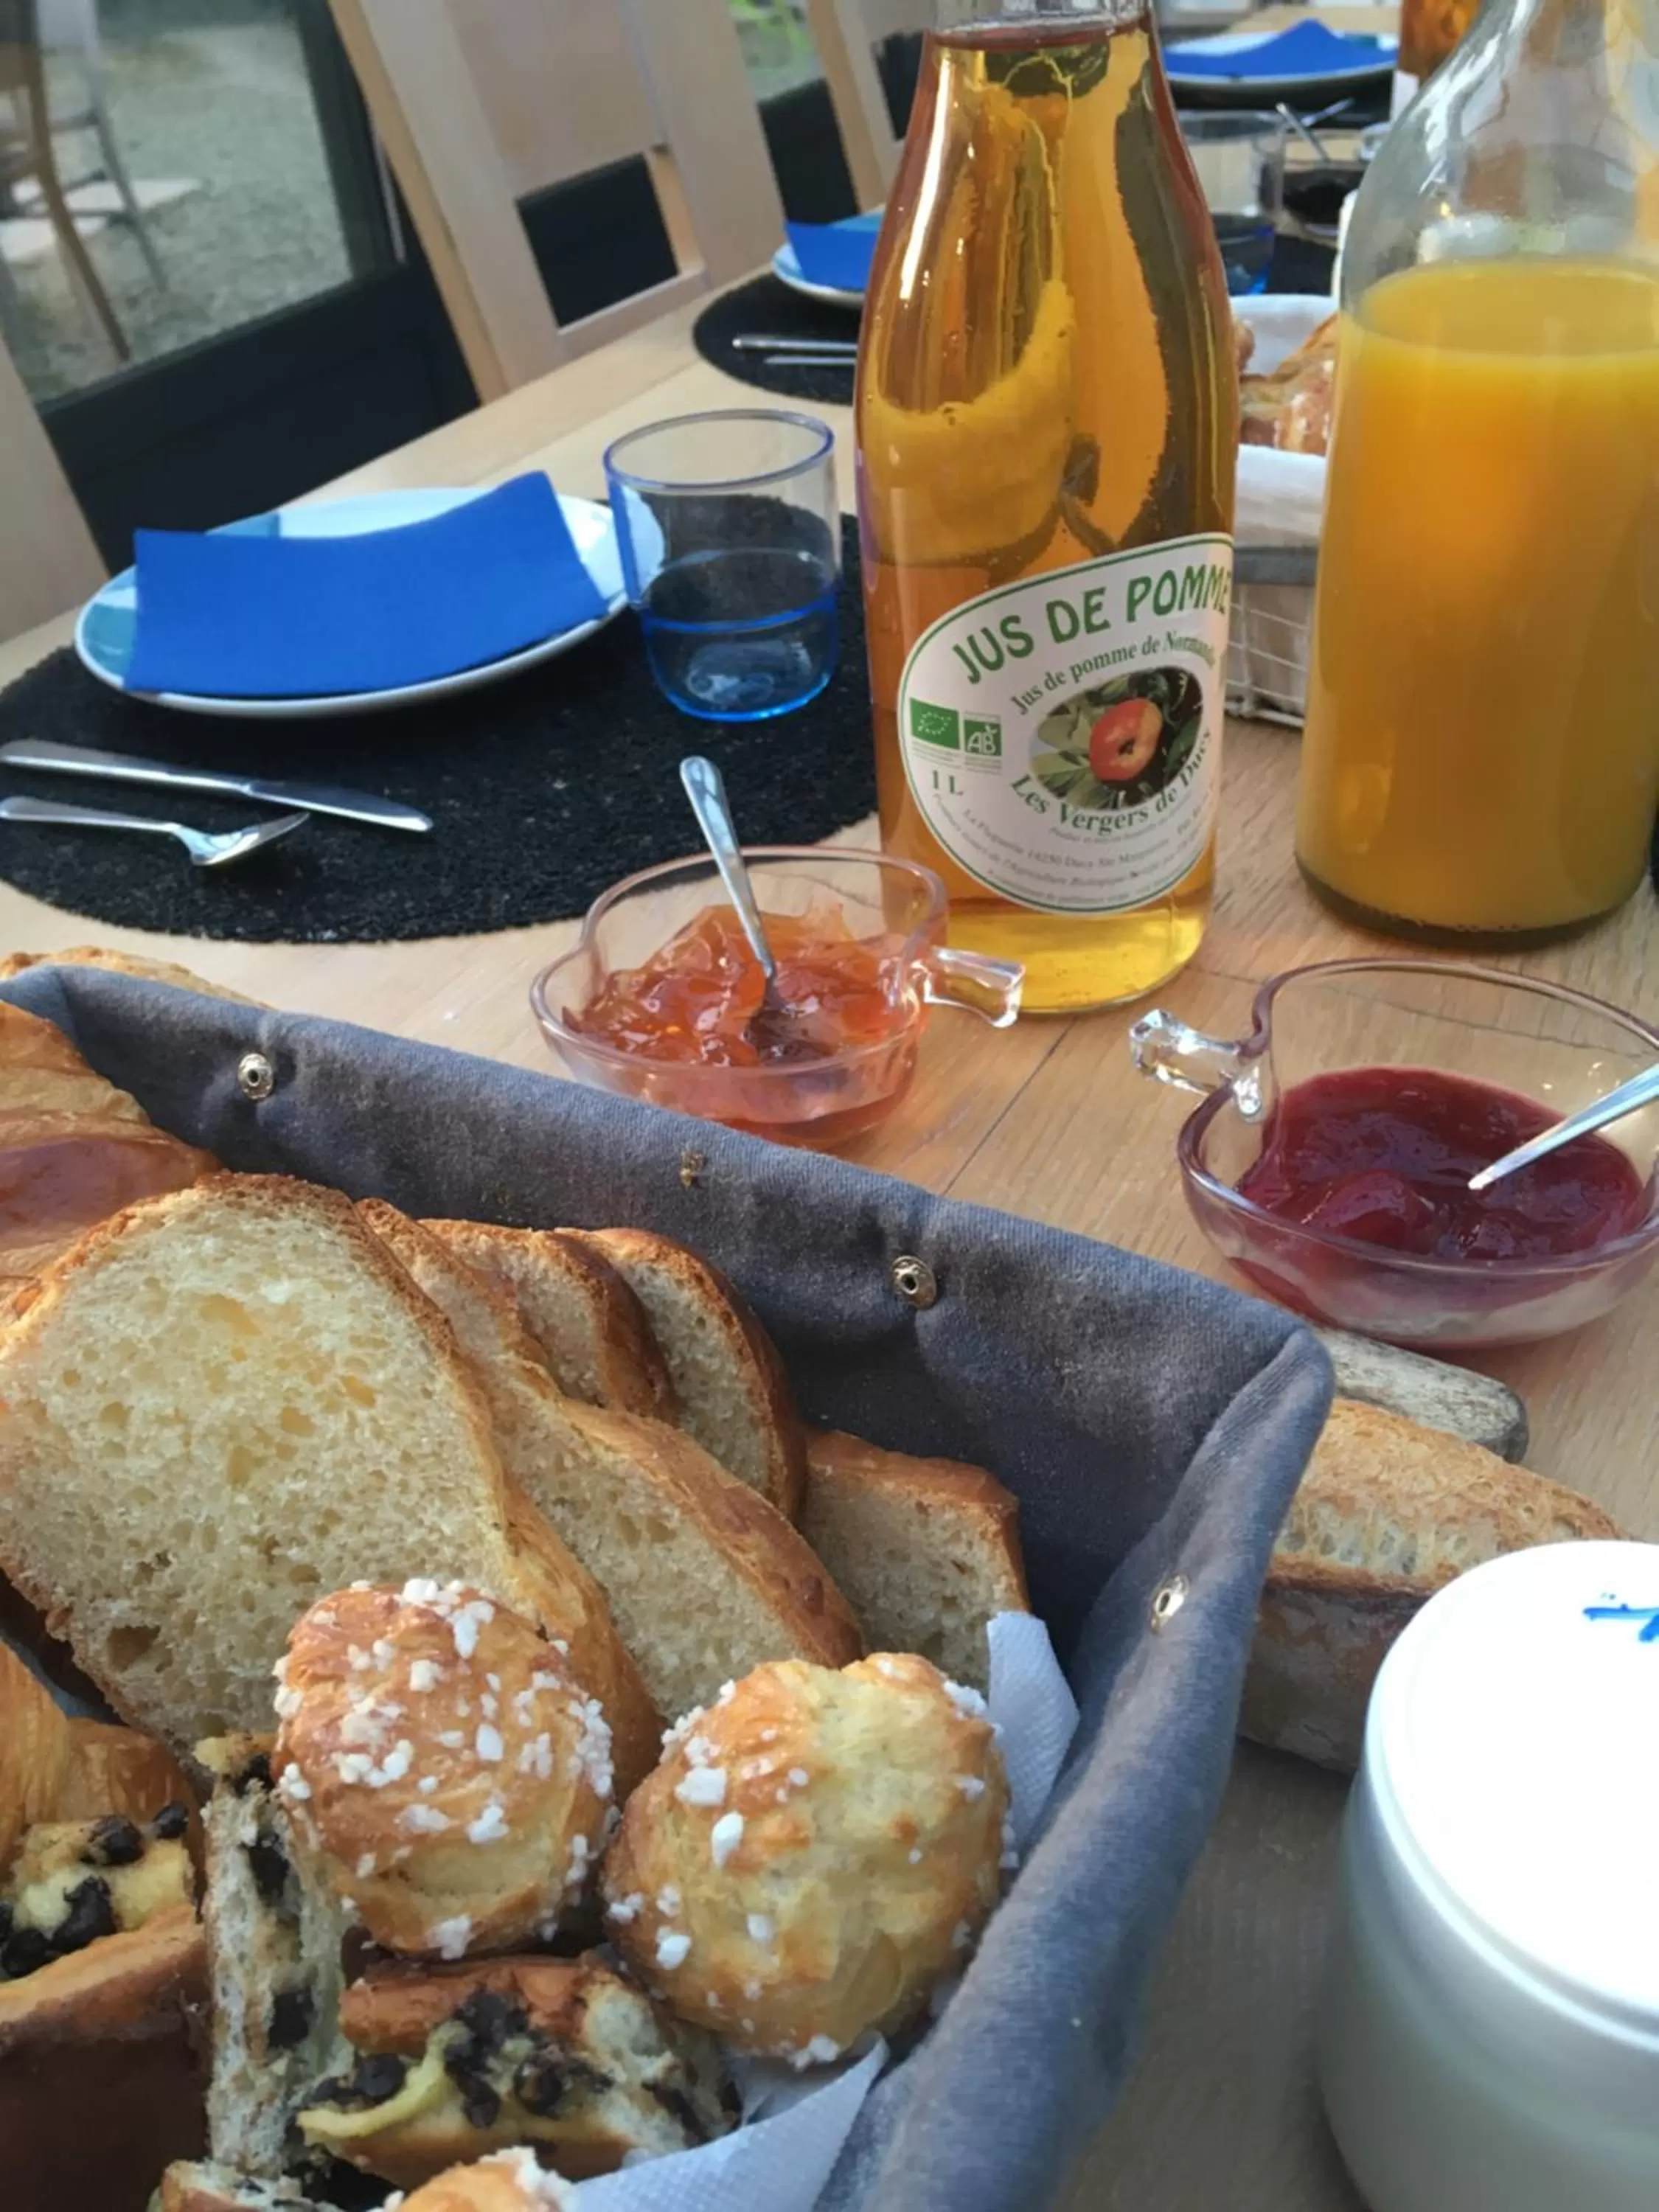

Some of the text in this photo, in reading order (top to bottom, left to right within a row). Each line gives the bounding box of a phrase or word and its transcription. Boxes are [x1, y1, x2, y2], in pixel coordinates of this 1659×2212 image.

[952, 563, 1232, 685] JUS DE POMME
[1011, 685, 1043, 715] Jus
[1044, 671, 1066, 691] de
[1070, 643, 1137, 684] pomme
[1141, 634, 1161, 655] de
[948, 774, 964, 794] L
[1010, 773, 1051, 814] Les
[1059, 800, 1150, 838] Vergers
[1155, 786, 1178, 813] de
